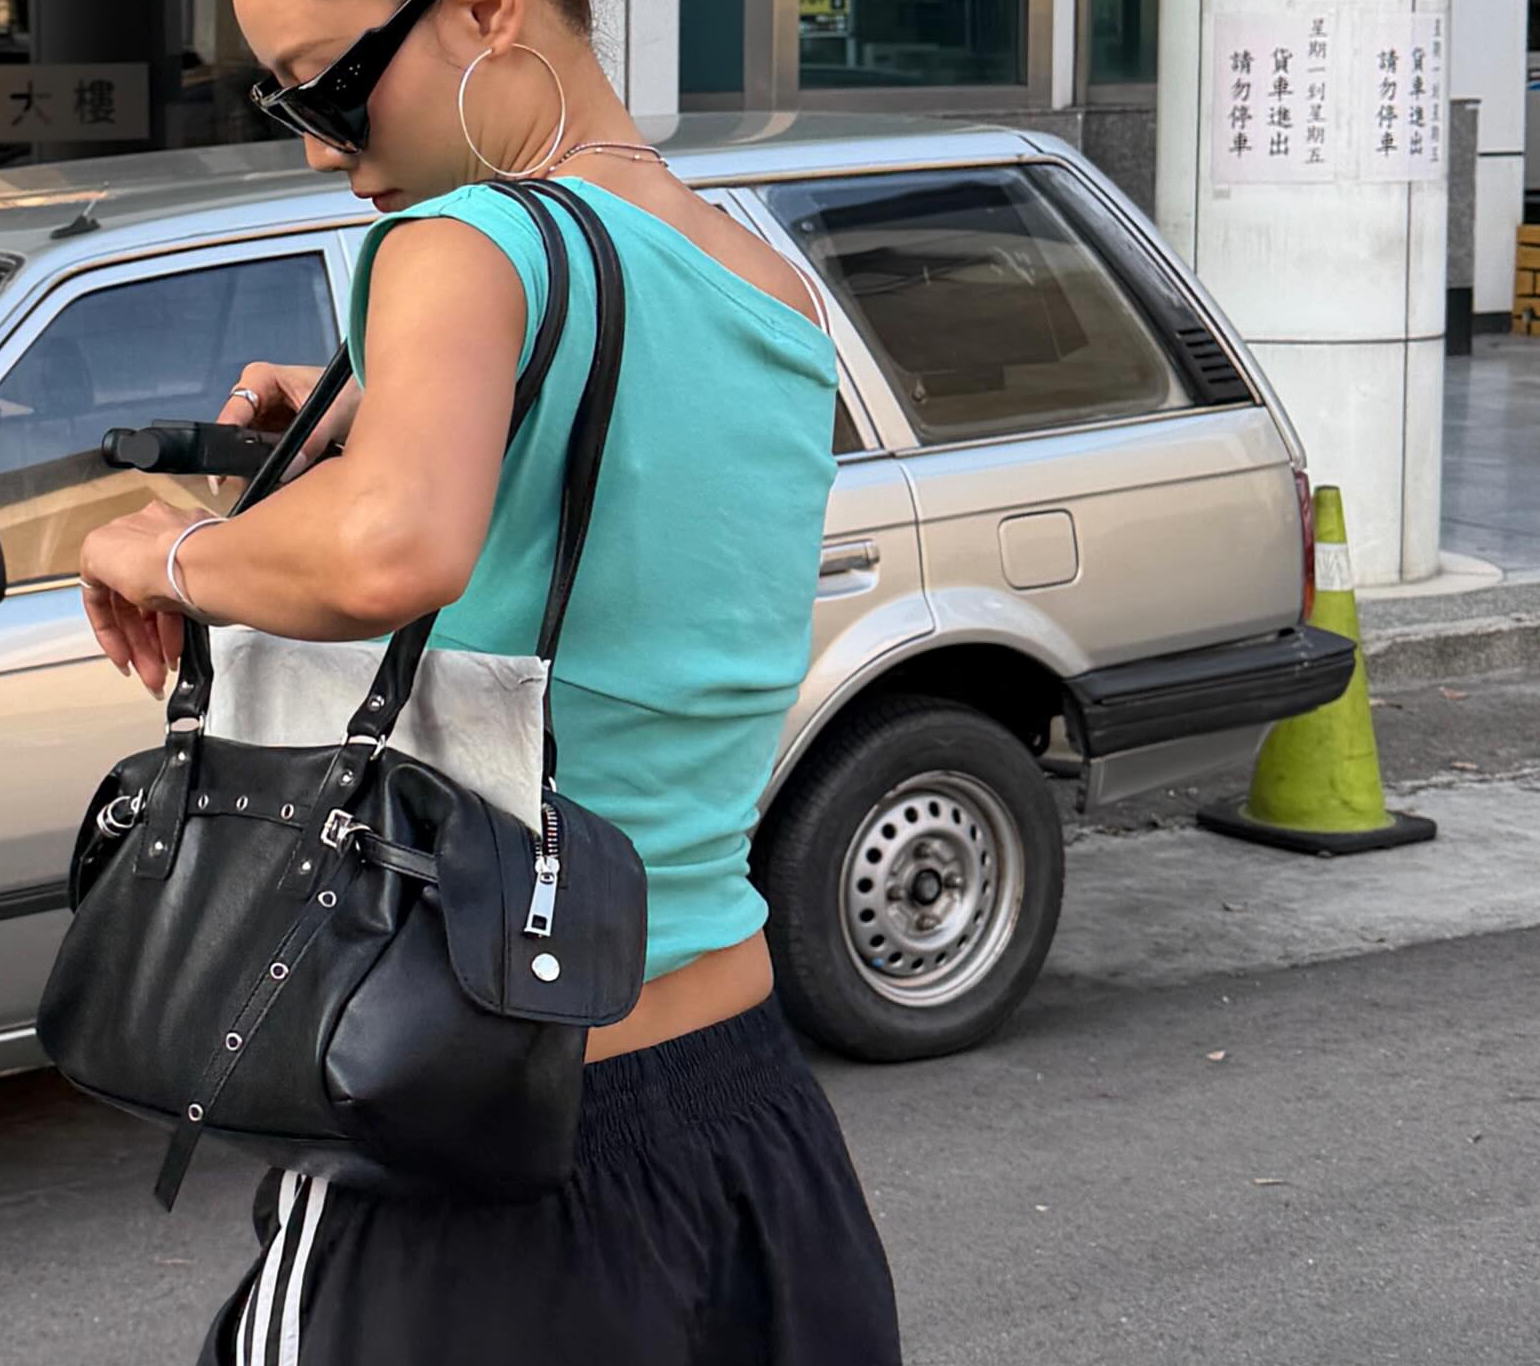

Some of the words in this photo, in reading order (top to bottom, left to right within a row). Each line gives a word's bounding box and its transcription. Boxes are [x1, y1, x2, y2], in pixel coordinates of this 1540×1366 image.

[1229, 48, 1254, 158] 請勿停車
[1268, 47, 1294, 156] 貨車進出
[1305, 18, 1328, 164] 星期一到星期五
[1376, 48, 1398, 157] 請勿停車
[1409, 47, 1426, 155] 貨車進出
